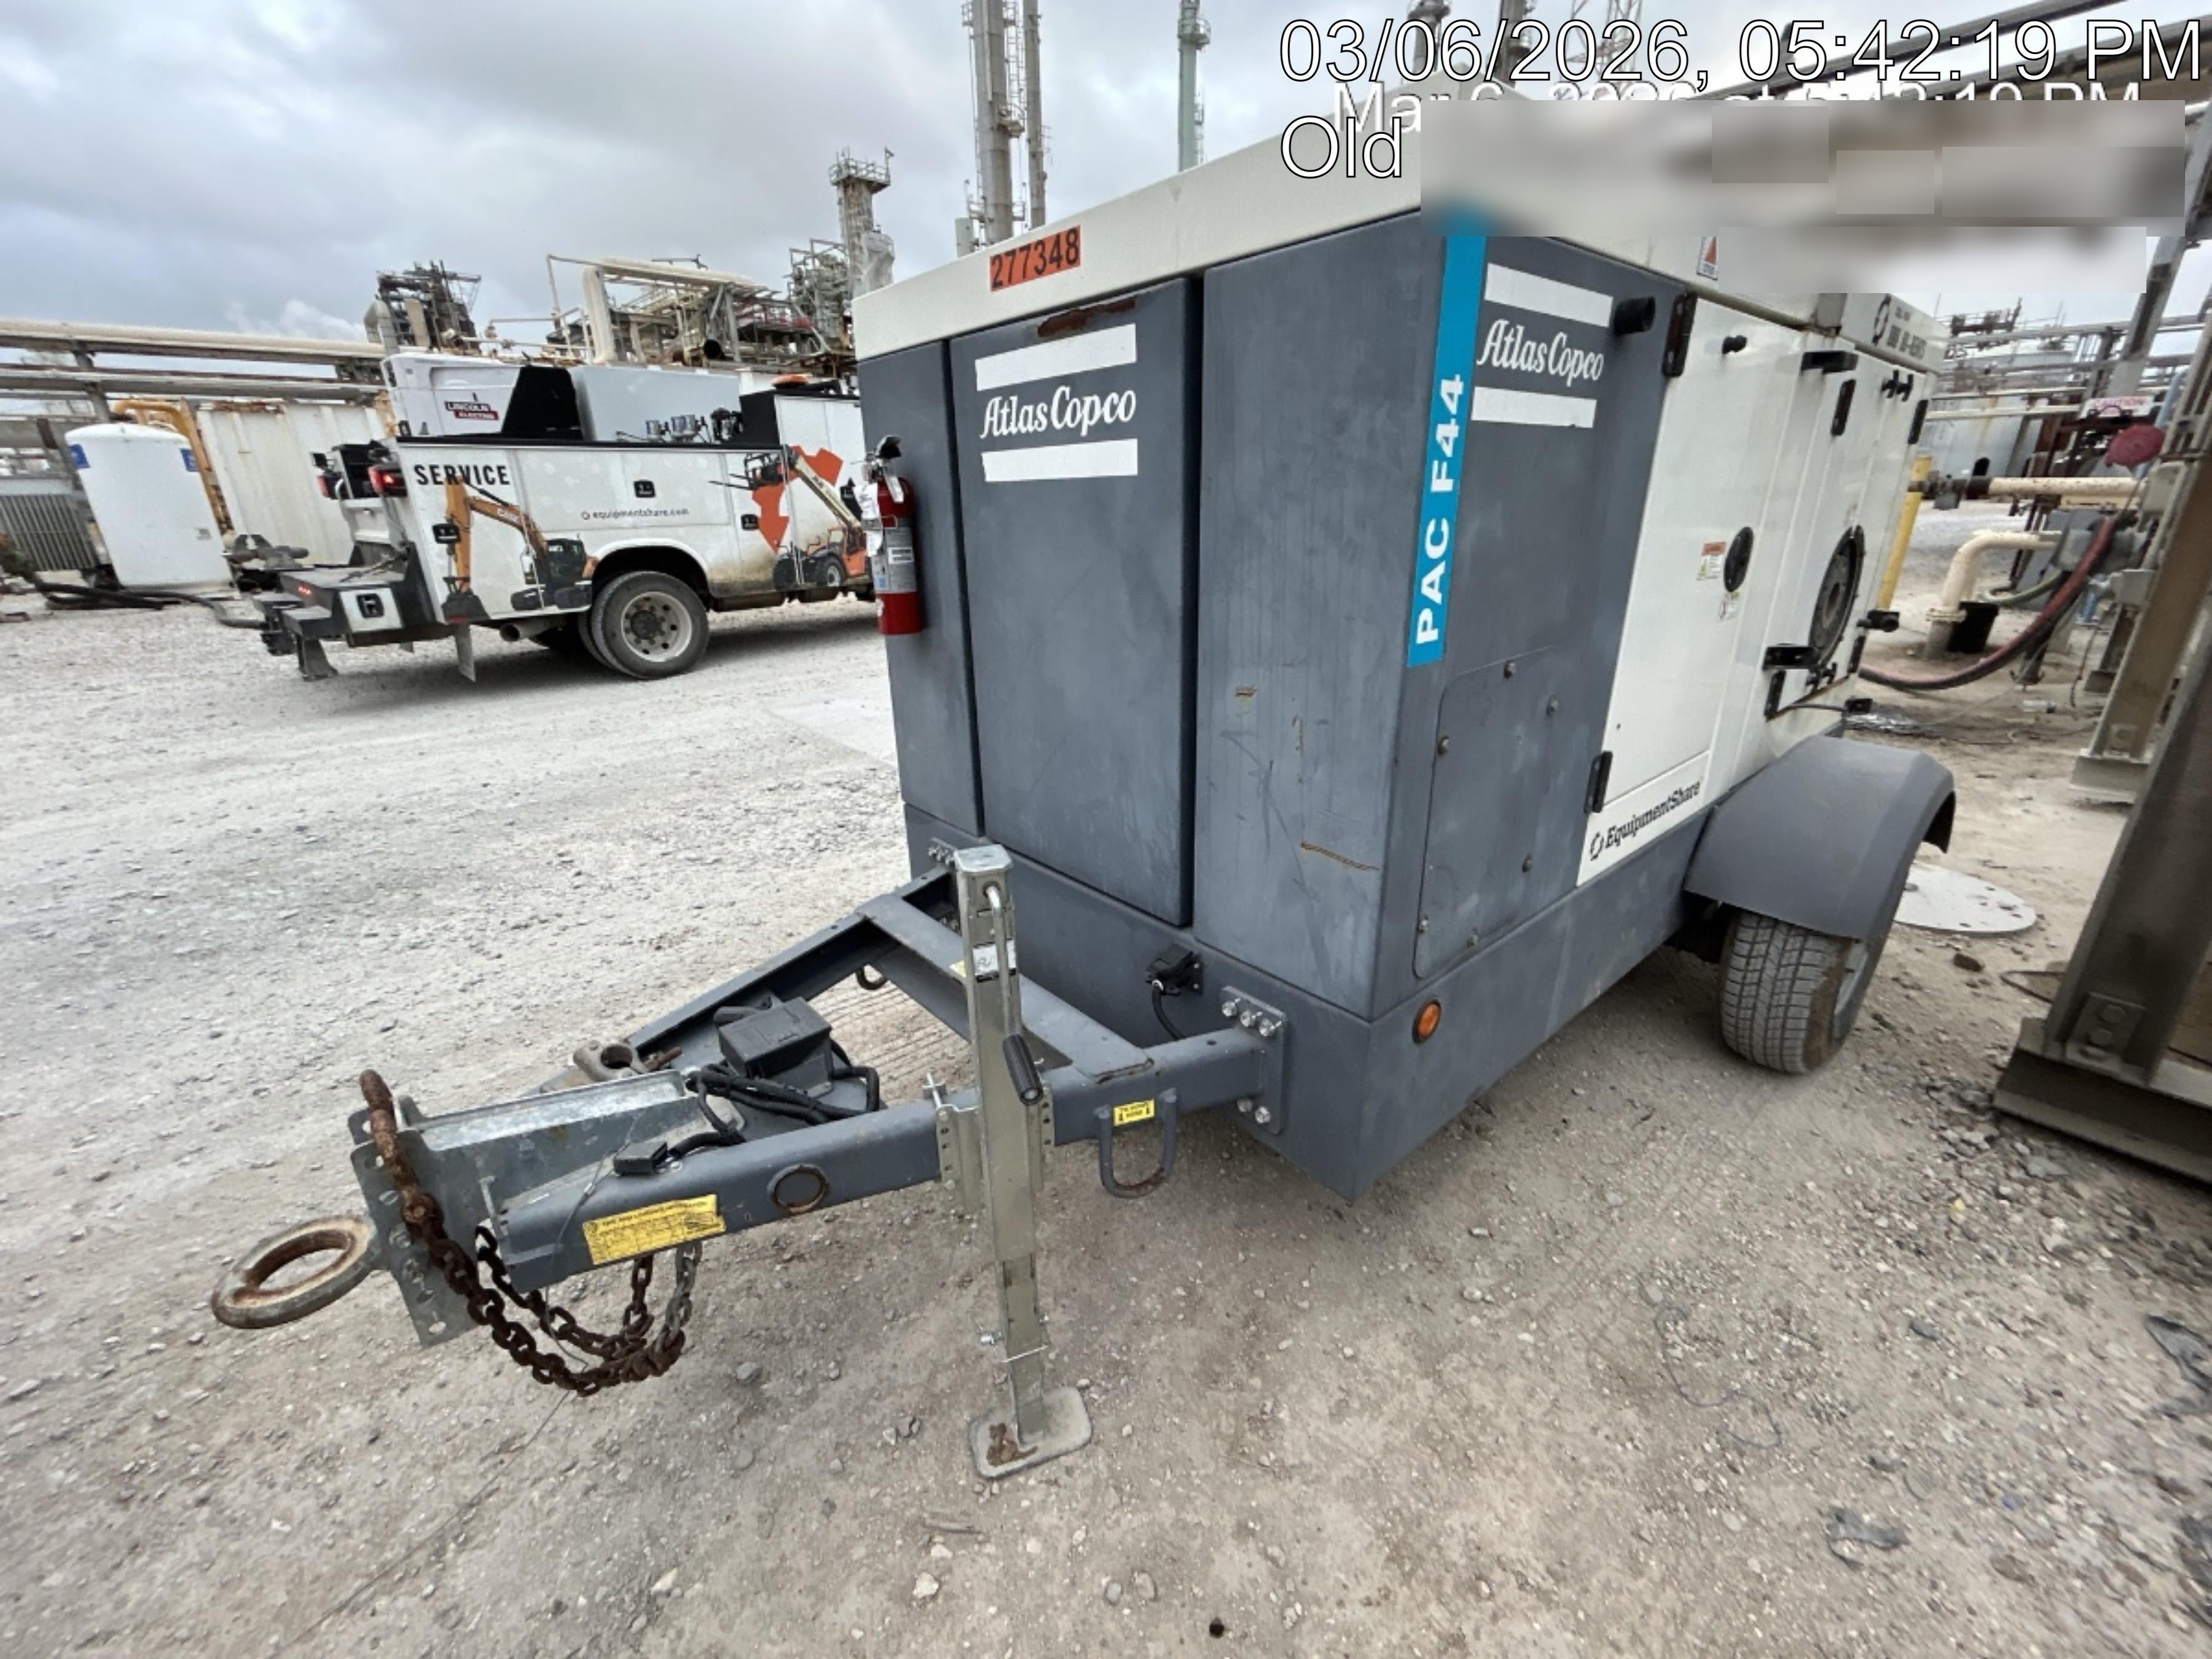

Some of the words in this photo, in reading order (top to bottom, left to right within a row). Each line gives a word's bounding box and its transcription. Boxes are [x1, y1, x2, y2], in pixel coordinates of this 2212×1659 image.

[990, 228, 1080, 289] 277348
[1477, 319, 1546, 374] Atlas
[1547, 332, 1604, 386] Copco
[980, 395, 1047, 439] Atlas
[1051, 385, 1137, 436] Copco
[1430, 374, 1465, 493] F44
[414, 464, 511, 485] SERVICE
[1415, 517, 1451, 645] PAC
[1605, 781, 1700, 849] EquipmentShare
